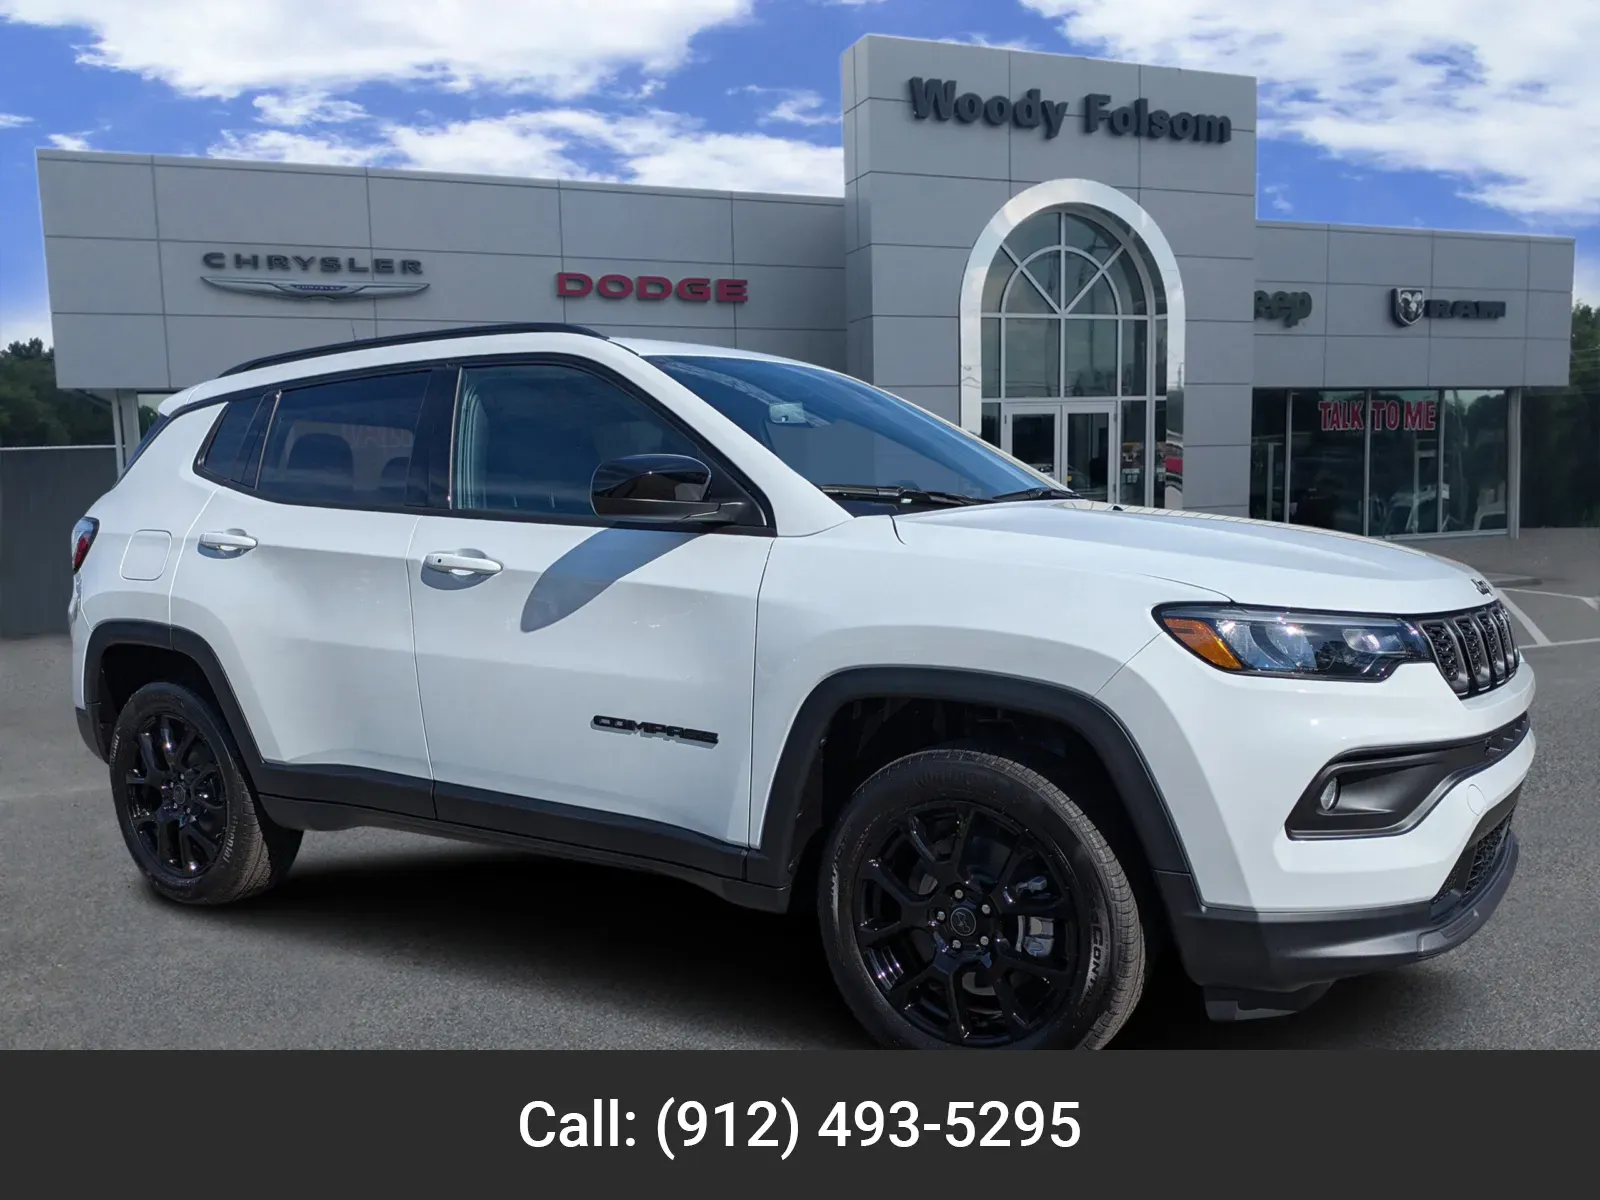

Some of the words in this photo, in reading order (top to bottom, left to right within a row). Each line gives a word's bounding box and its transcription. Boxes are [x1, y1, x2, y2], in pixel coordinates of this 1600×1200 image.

[909, 76, 1069, 140] Woody
[1085, 93, 1232, 144] Folsom
[202, 252, 424, 275] CHRYSLER
[556, 272, 749, 303] DODGE
[1254, 290, 1312, 328] eep
[1424, 299, 1506, 319] RAM
[1318, 401, 1364, 431] TALK
[1371, 401, 1400, 431] TO
[1403, 401, 1437, 431] ME
